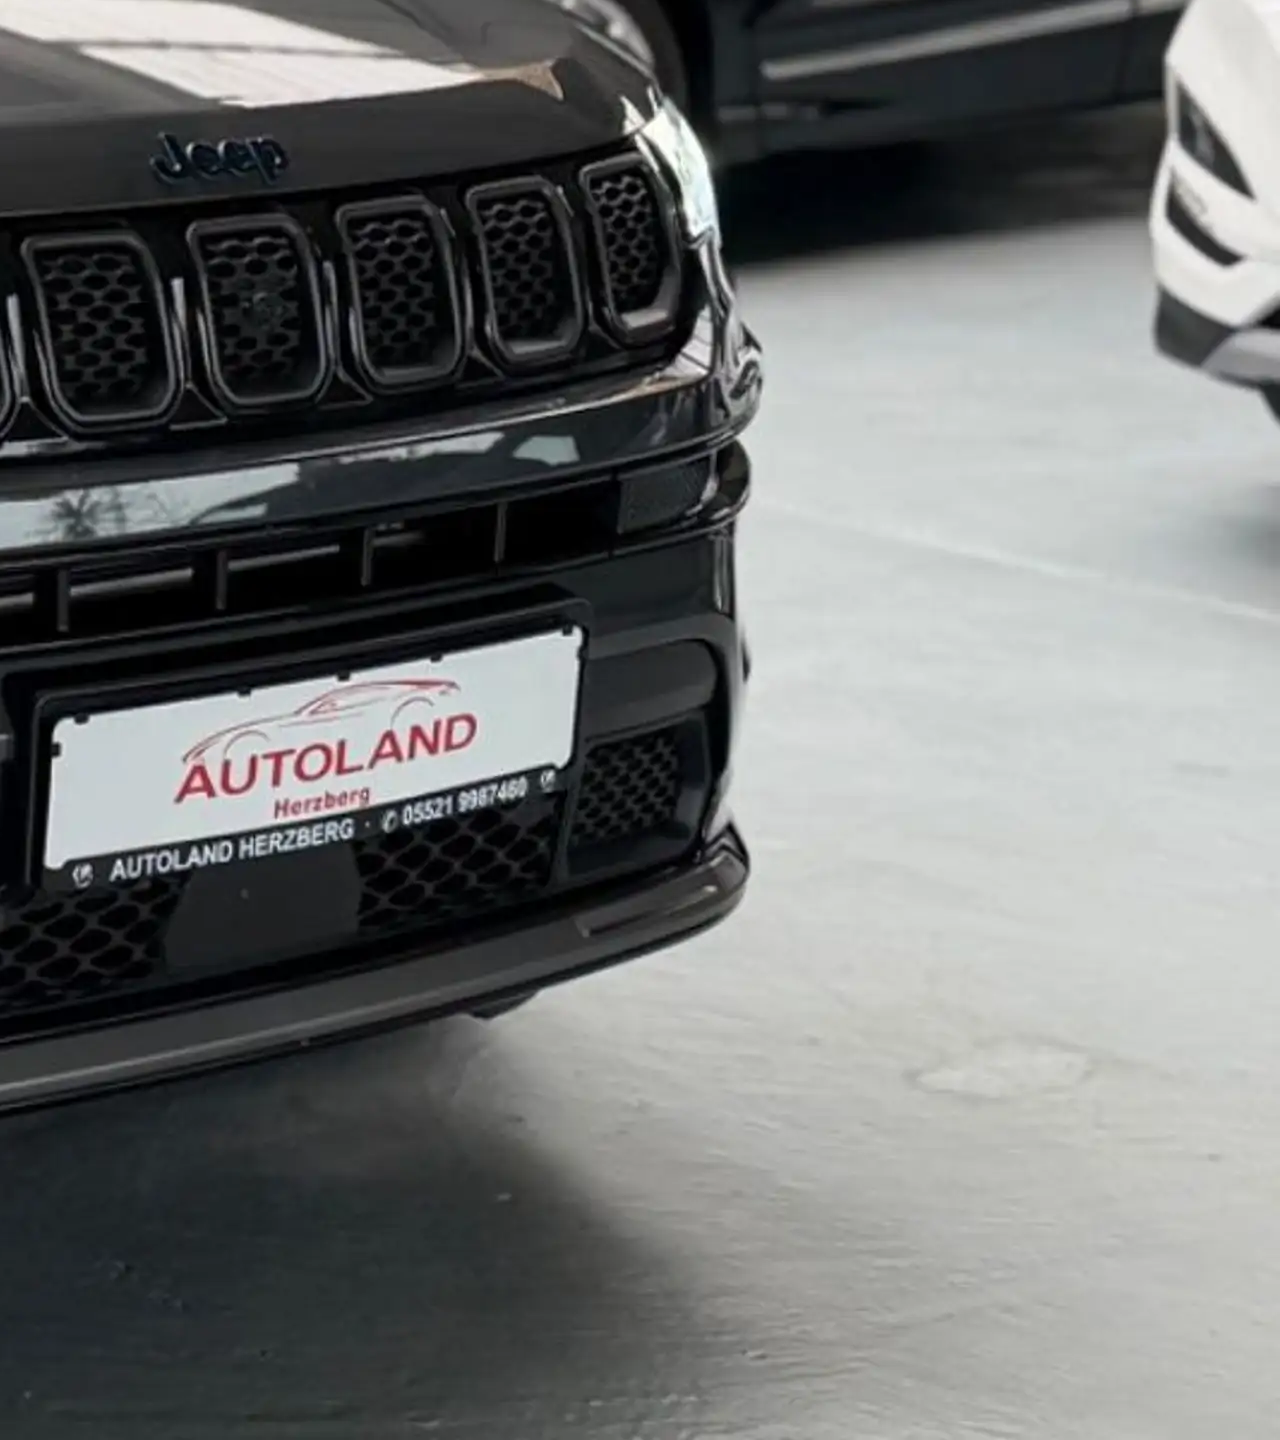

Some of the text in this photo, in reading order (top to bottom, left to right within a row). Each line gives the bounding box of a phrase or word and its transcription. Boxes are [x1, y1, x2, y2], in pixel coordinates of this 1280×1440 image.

[150, 133, 289, 185] Jeep
[174, 713, 478, 803] AUTOLAND
[273, 786, 371, 819] Herzberg
[109, 841, 232, 881] AUTOLAND
[240, 820, 354, 860] HERZBERG
[402, 797, 453, 825] 05521
